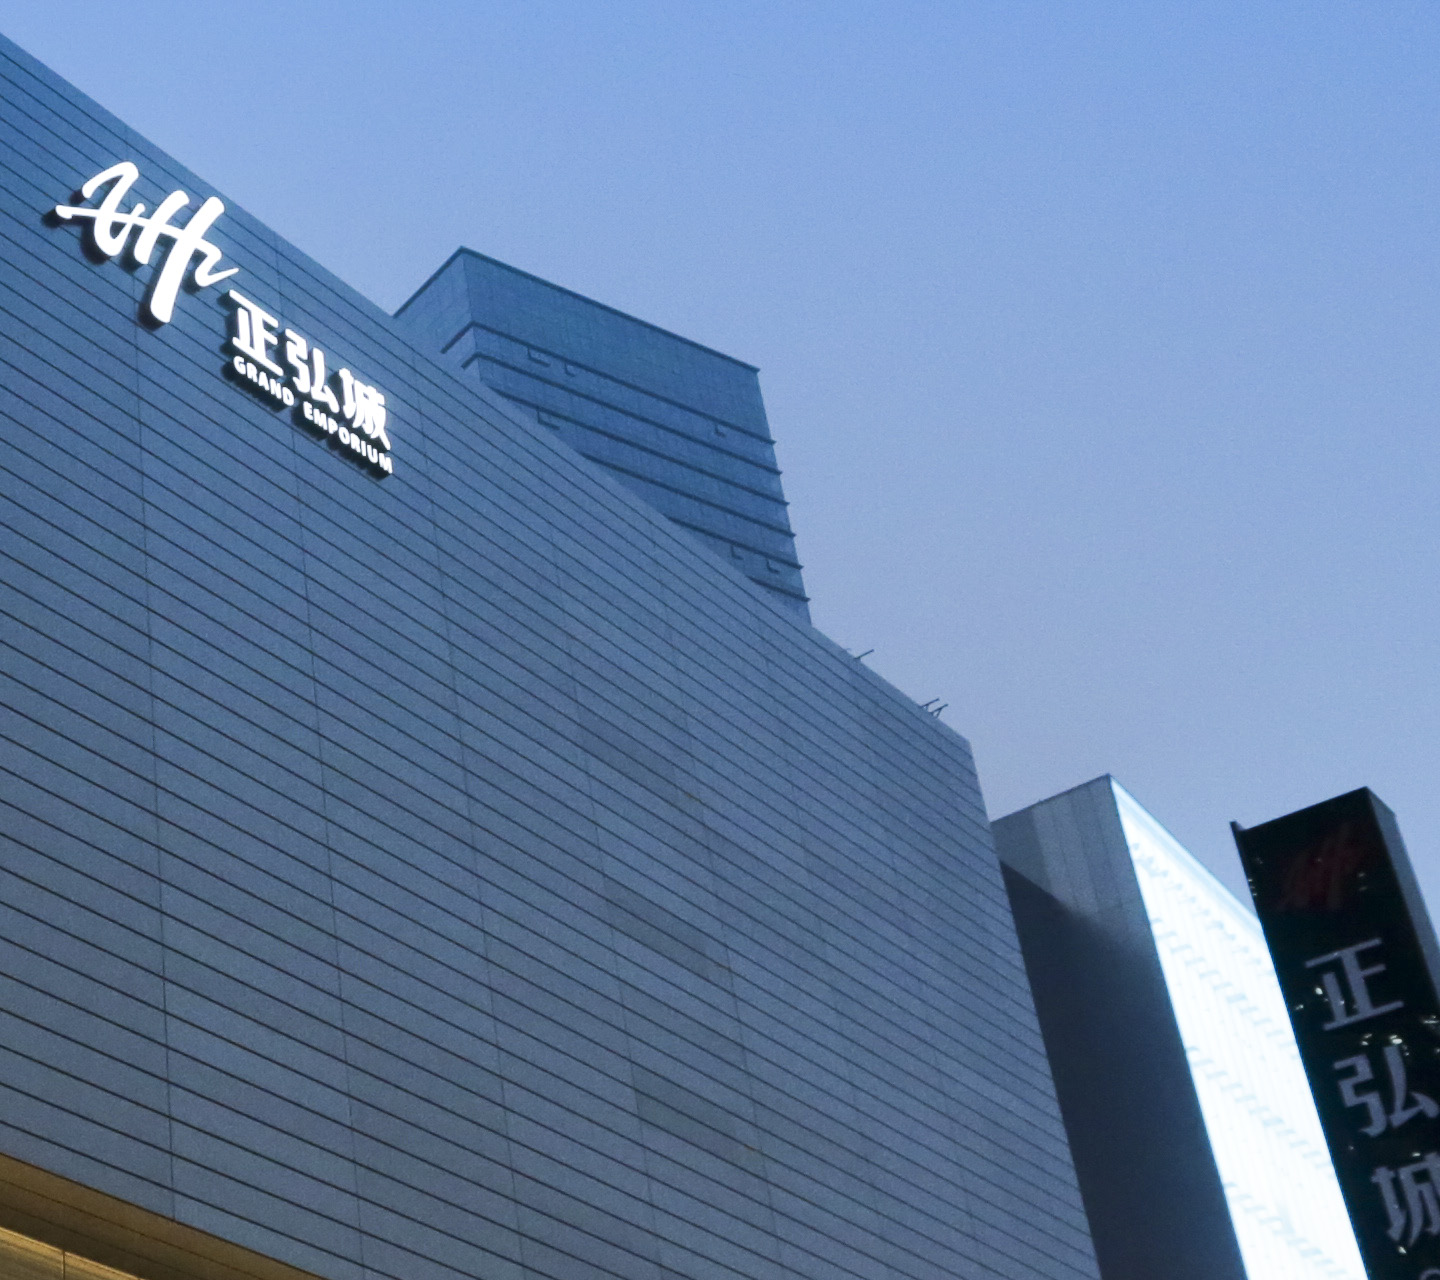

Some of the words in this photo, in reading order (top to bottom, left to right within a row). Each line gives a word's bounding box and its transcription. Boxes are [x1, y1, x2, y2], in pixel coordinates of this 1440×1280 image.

[229, 288, 391, 450] 正弘城
[232, 355, 295, 407] GRAND
[303, 401, 394, 474] EMPORIUM
